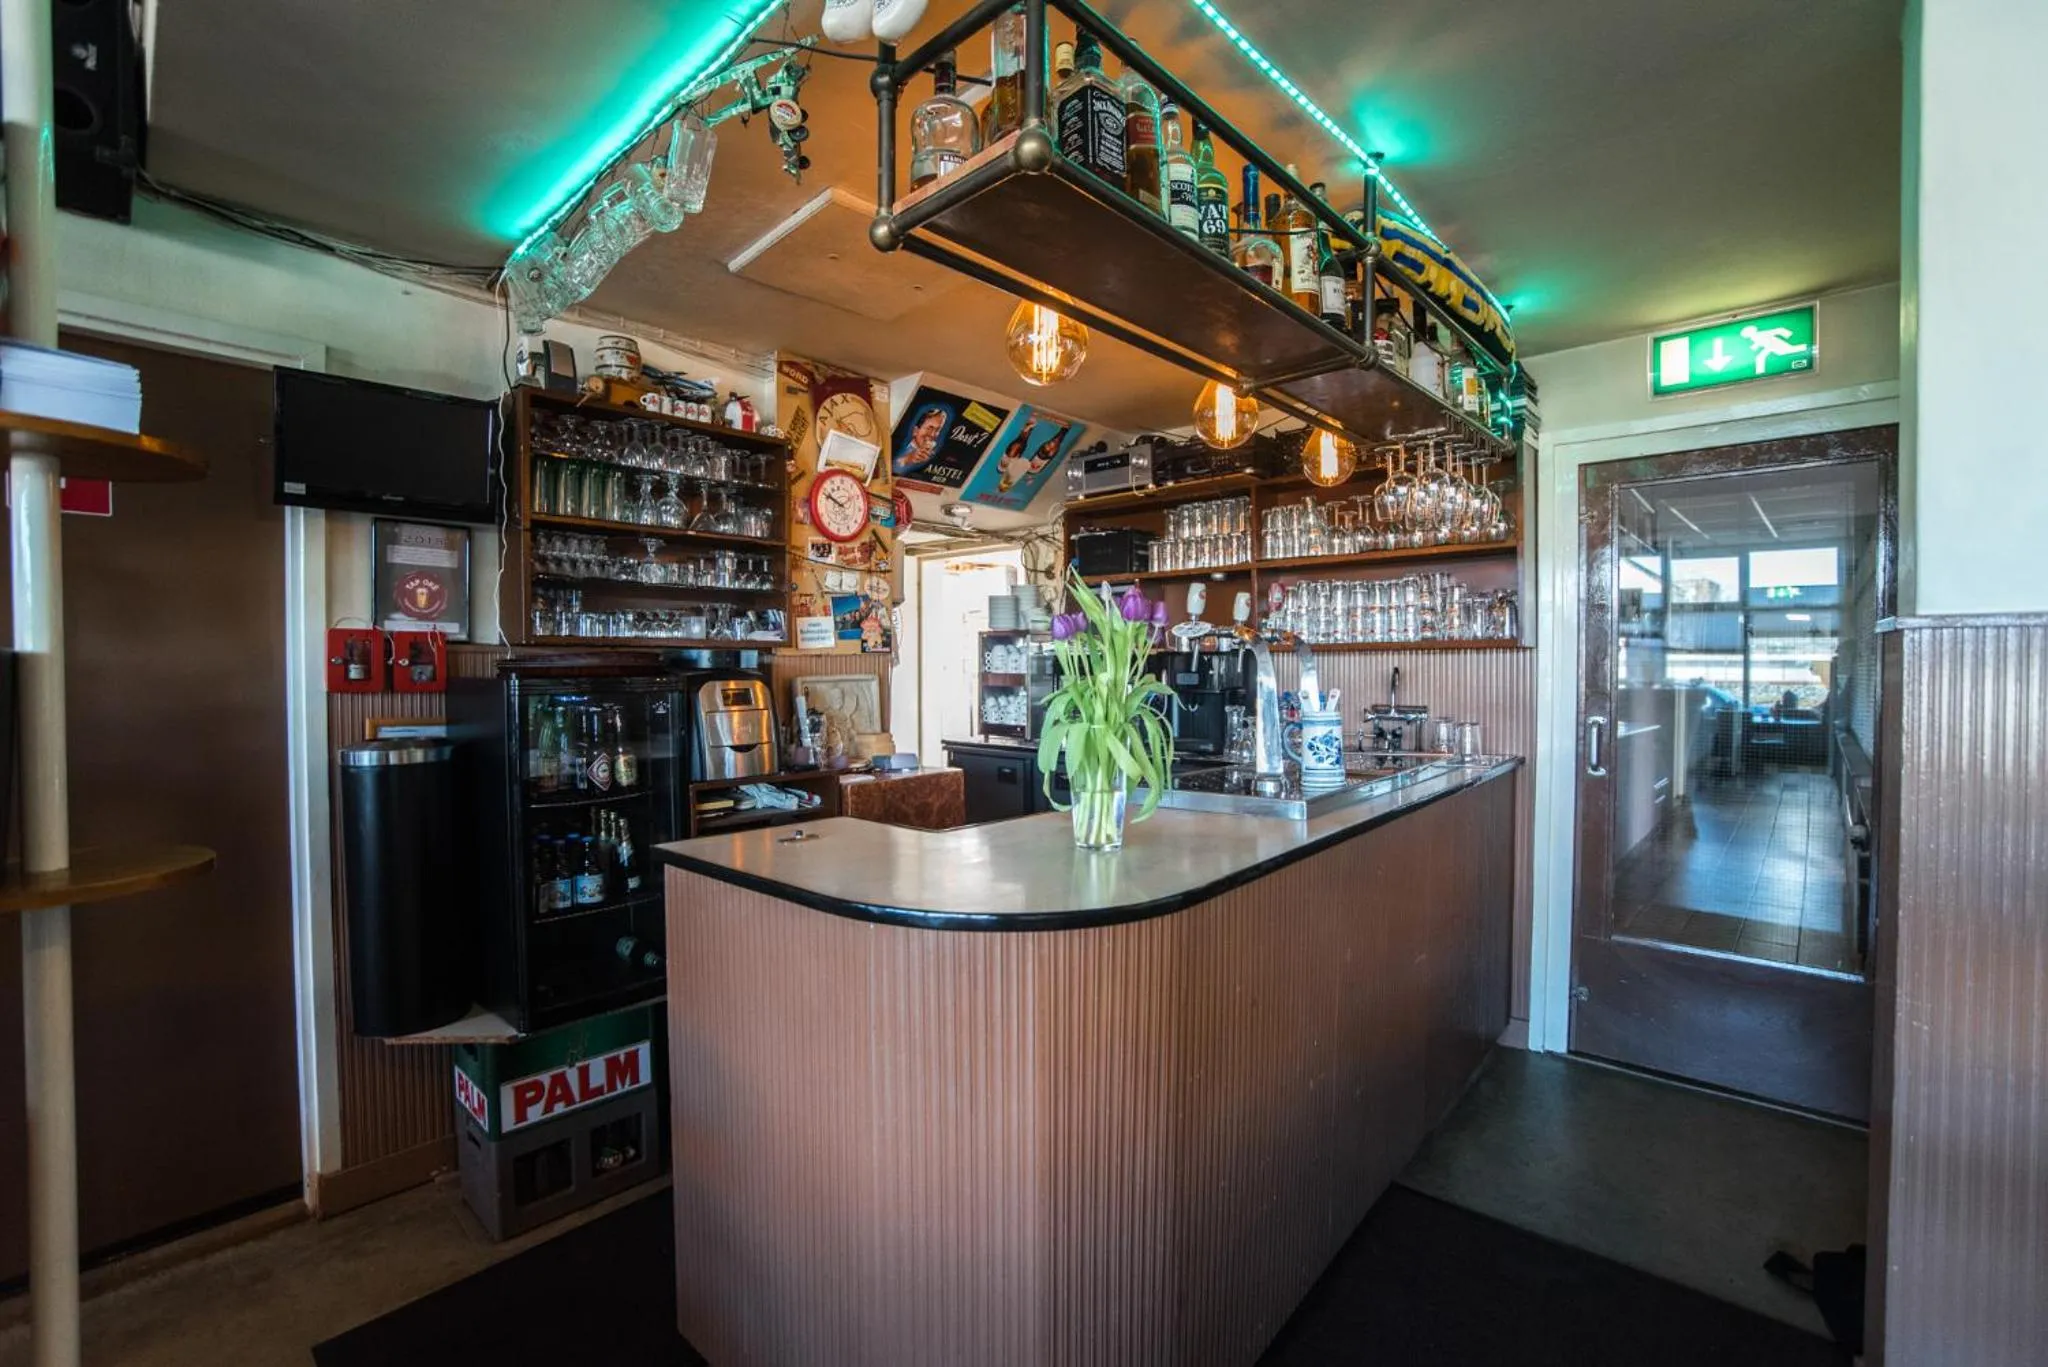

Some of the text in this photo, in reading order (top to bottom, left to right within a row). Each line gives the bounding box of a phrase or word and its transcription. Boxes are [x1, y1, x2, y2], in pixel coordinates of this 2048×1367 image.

[1198, 203, 1227, 220] VAT
[1202, 219, 1226, 234] 69
[818, 394, 850, 426] AJAX
[923, 463, 965, 481] AMSTEL
[457, 1071, 486, 1123] PALM
[512, 1047, 641, 1126] PALM
